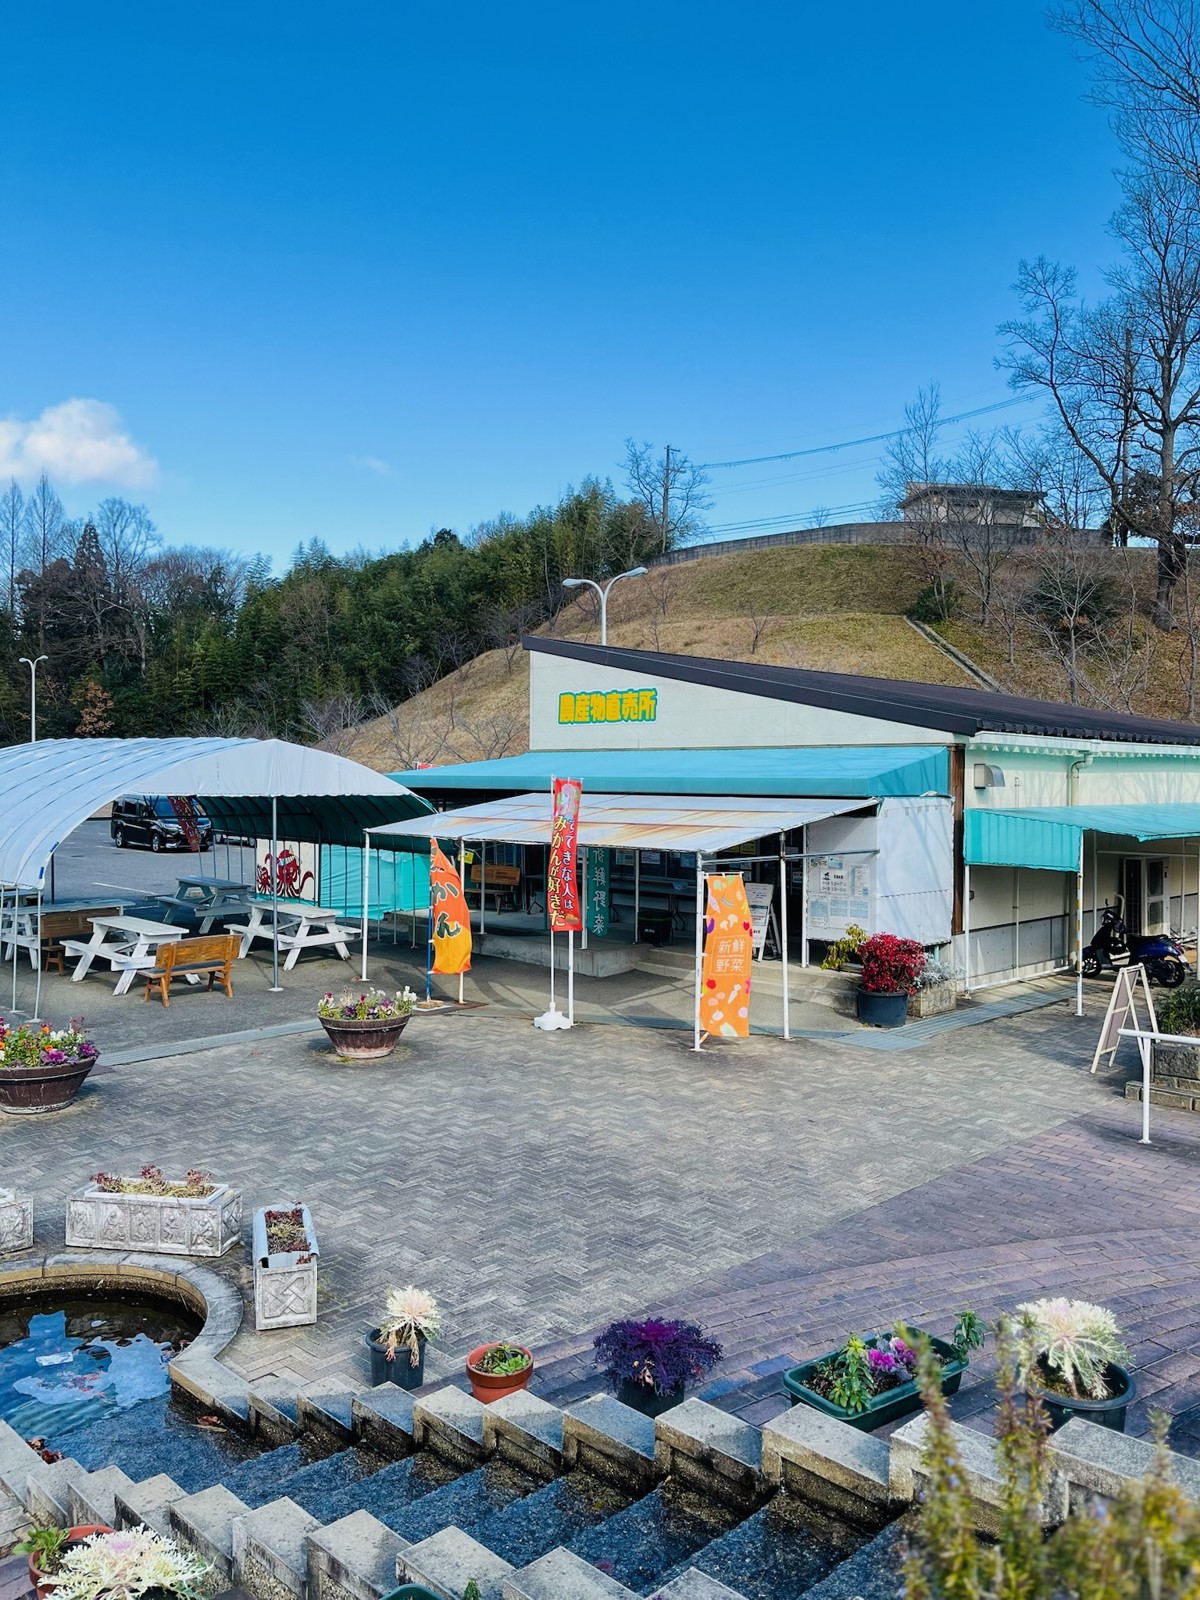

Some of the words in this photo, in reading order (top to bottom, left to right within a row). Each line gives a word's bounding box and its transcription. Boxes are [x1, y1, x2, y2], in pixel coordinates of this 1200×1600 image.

[558, 688, 657, 724] 農産物直売所
[548, 815, 567, 927] みかんが好きだ
[561, 820, 575, 910] すてきな人は
[719, 938, 745, 954] 新鮮
[715, 958, 744, 973] 野菜
